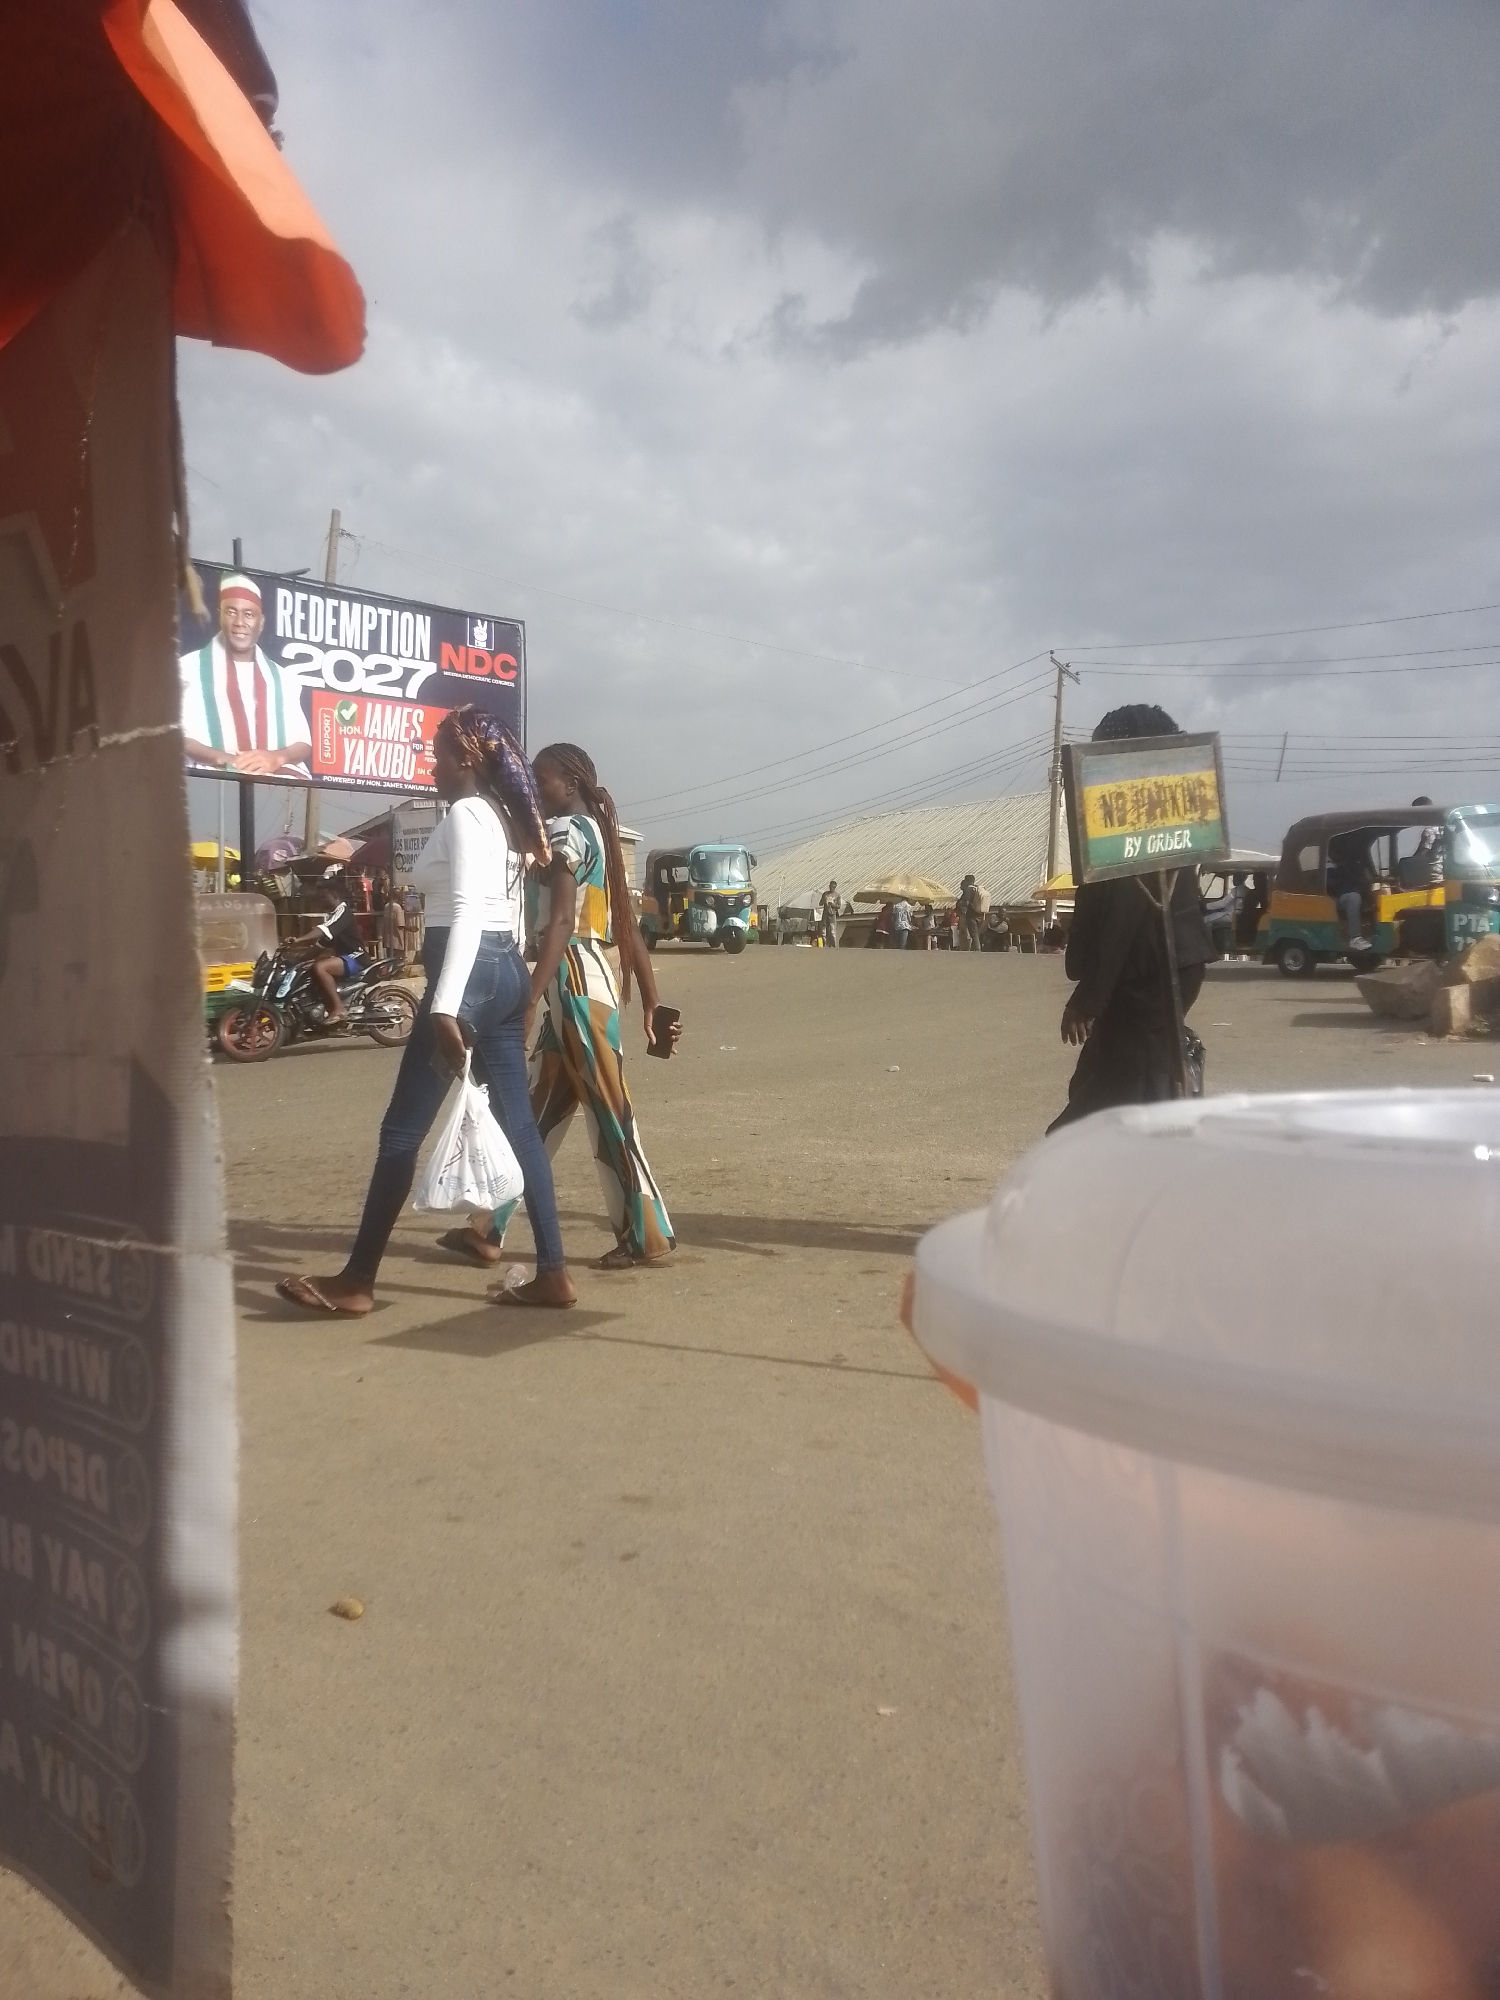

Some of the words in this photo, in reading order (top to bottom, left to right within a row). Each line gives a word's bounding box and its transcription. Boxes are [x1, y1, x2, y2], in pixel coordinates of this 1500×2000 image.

[276, 587, 432, 661] REDEMPTION
[281, 642, 437, 699] 2027
[440, 641, 517, 680] NDC
[323, 713, 332, 759] SUPPORT
[339, 726, 362, 736] HON.
[364, 702, 424, 743] JAMES
[343, 738, 416, 781] YAKUBU
[413, 743, 424, 751] FOR
[323, 775, 355, 784] POWERED
[356, 778, 366, 786] BY
[383, 782, 402, 790] JAMES
[417, 767, 426, 775] IN
[1100, 791, 1127, 829] NO
[1124, 837, 1142, 858] BY
[1147, 829, 1193, 854] ORDER
[1454, 913, 1490, 932] PTA
